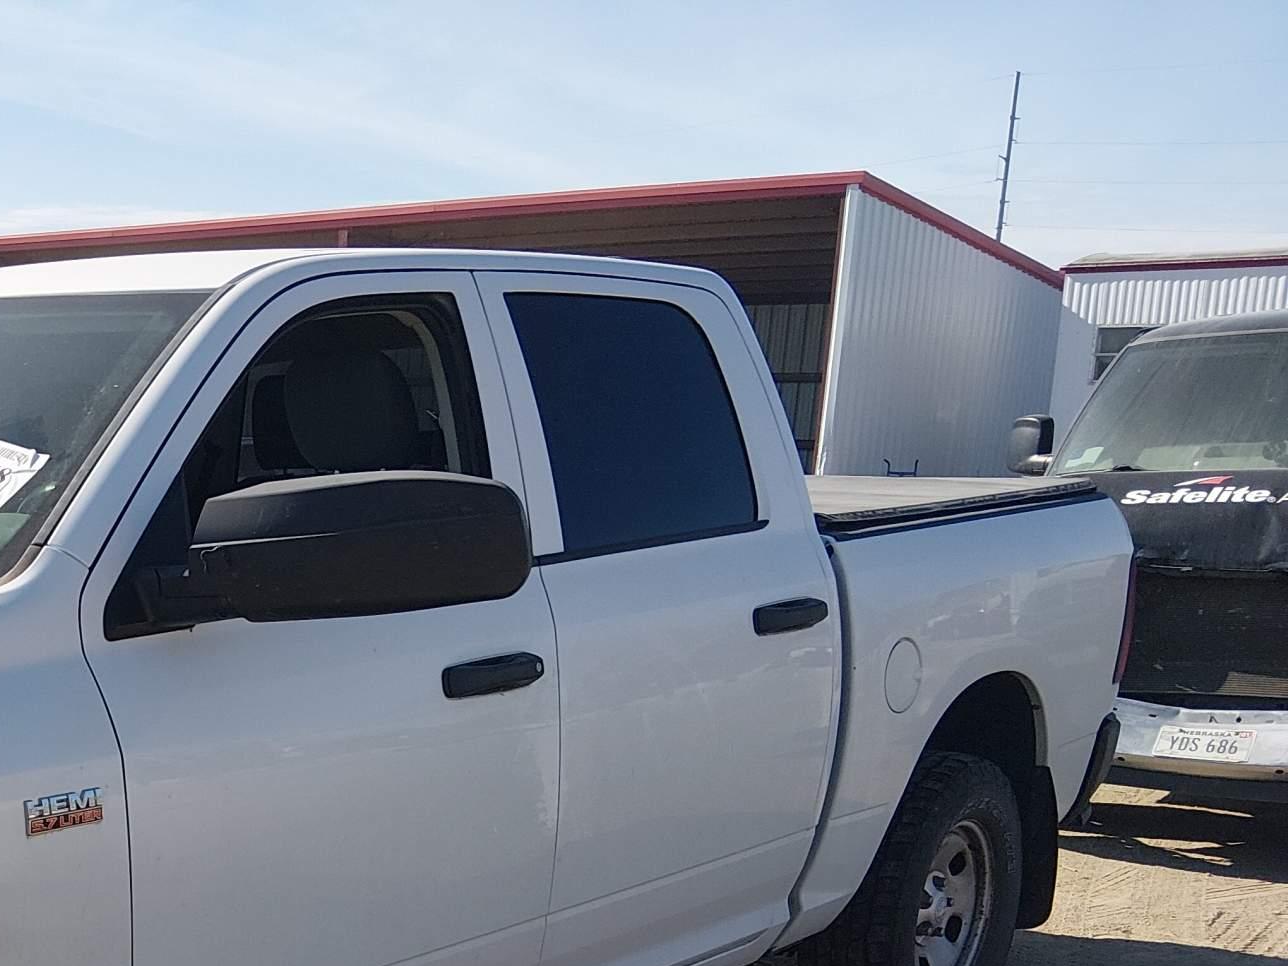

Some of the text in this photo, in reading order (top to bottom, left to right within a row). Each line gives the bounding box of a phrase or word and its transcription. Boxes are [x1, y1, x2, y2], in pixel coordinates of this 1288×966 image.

[1170, 735, 1239, 755] YDS 686
[59, 808, 102, 828] LITER
